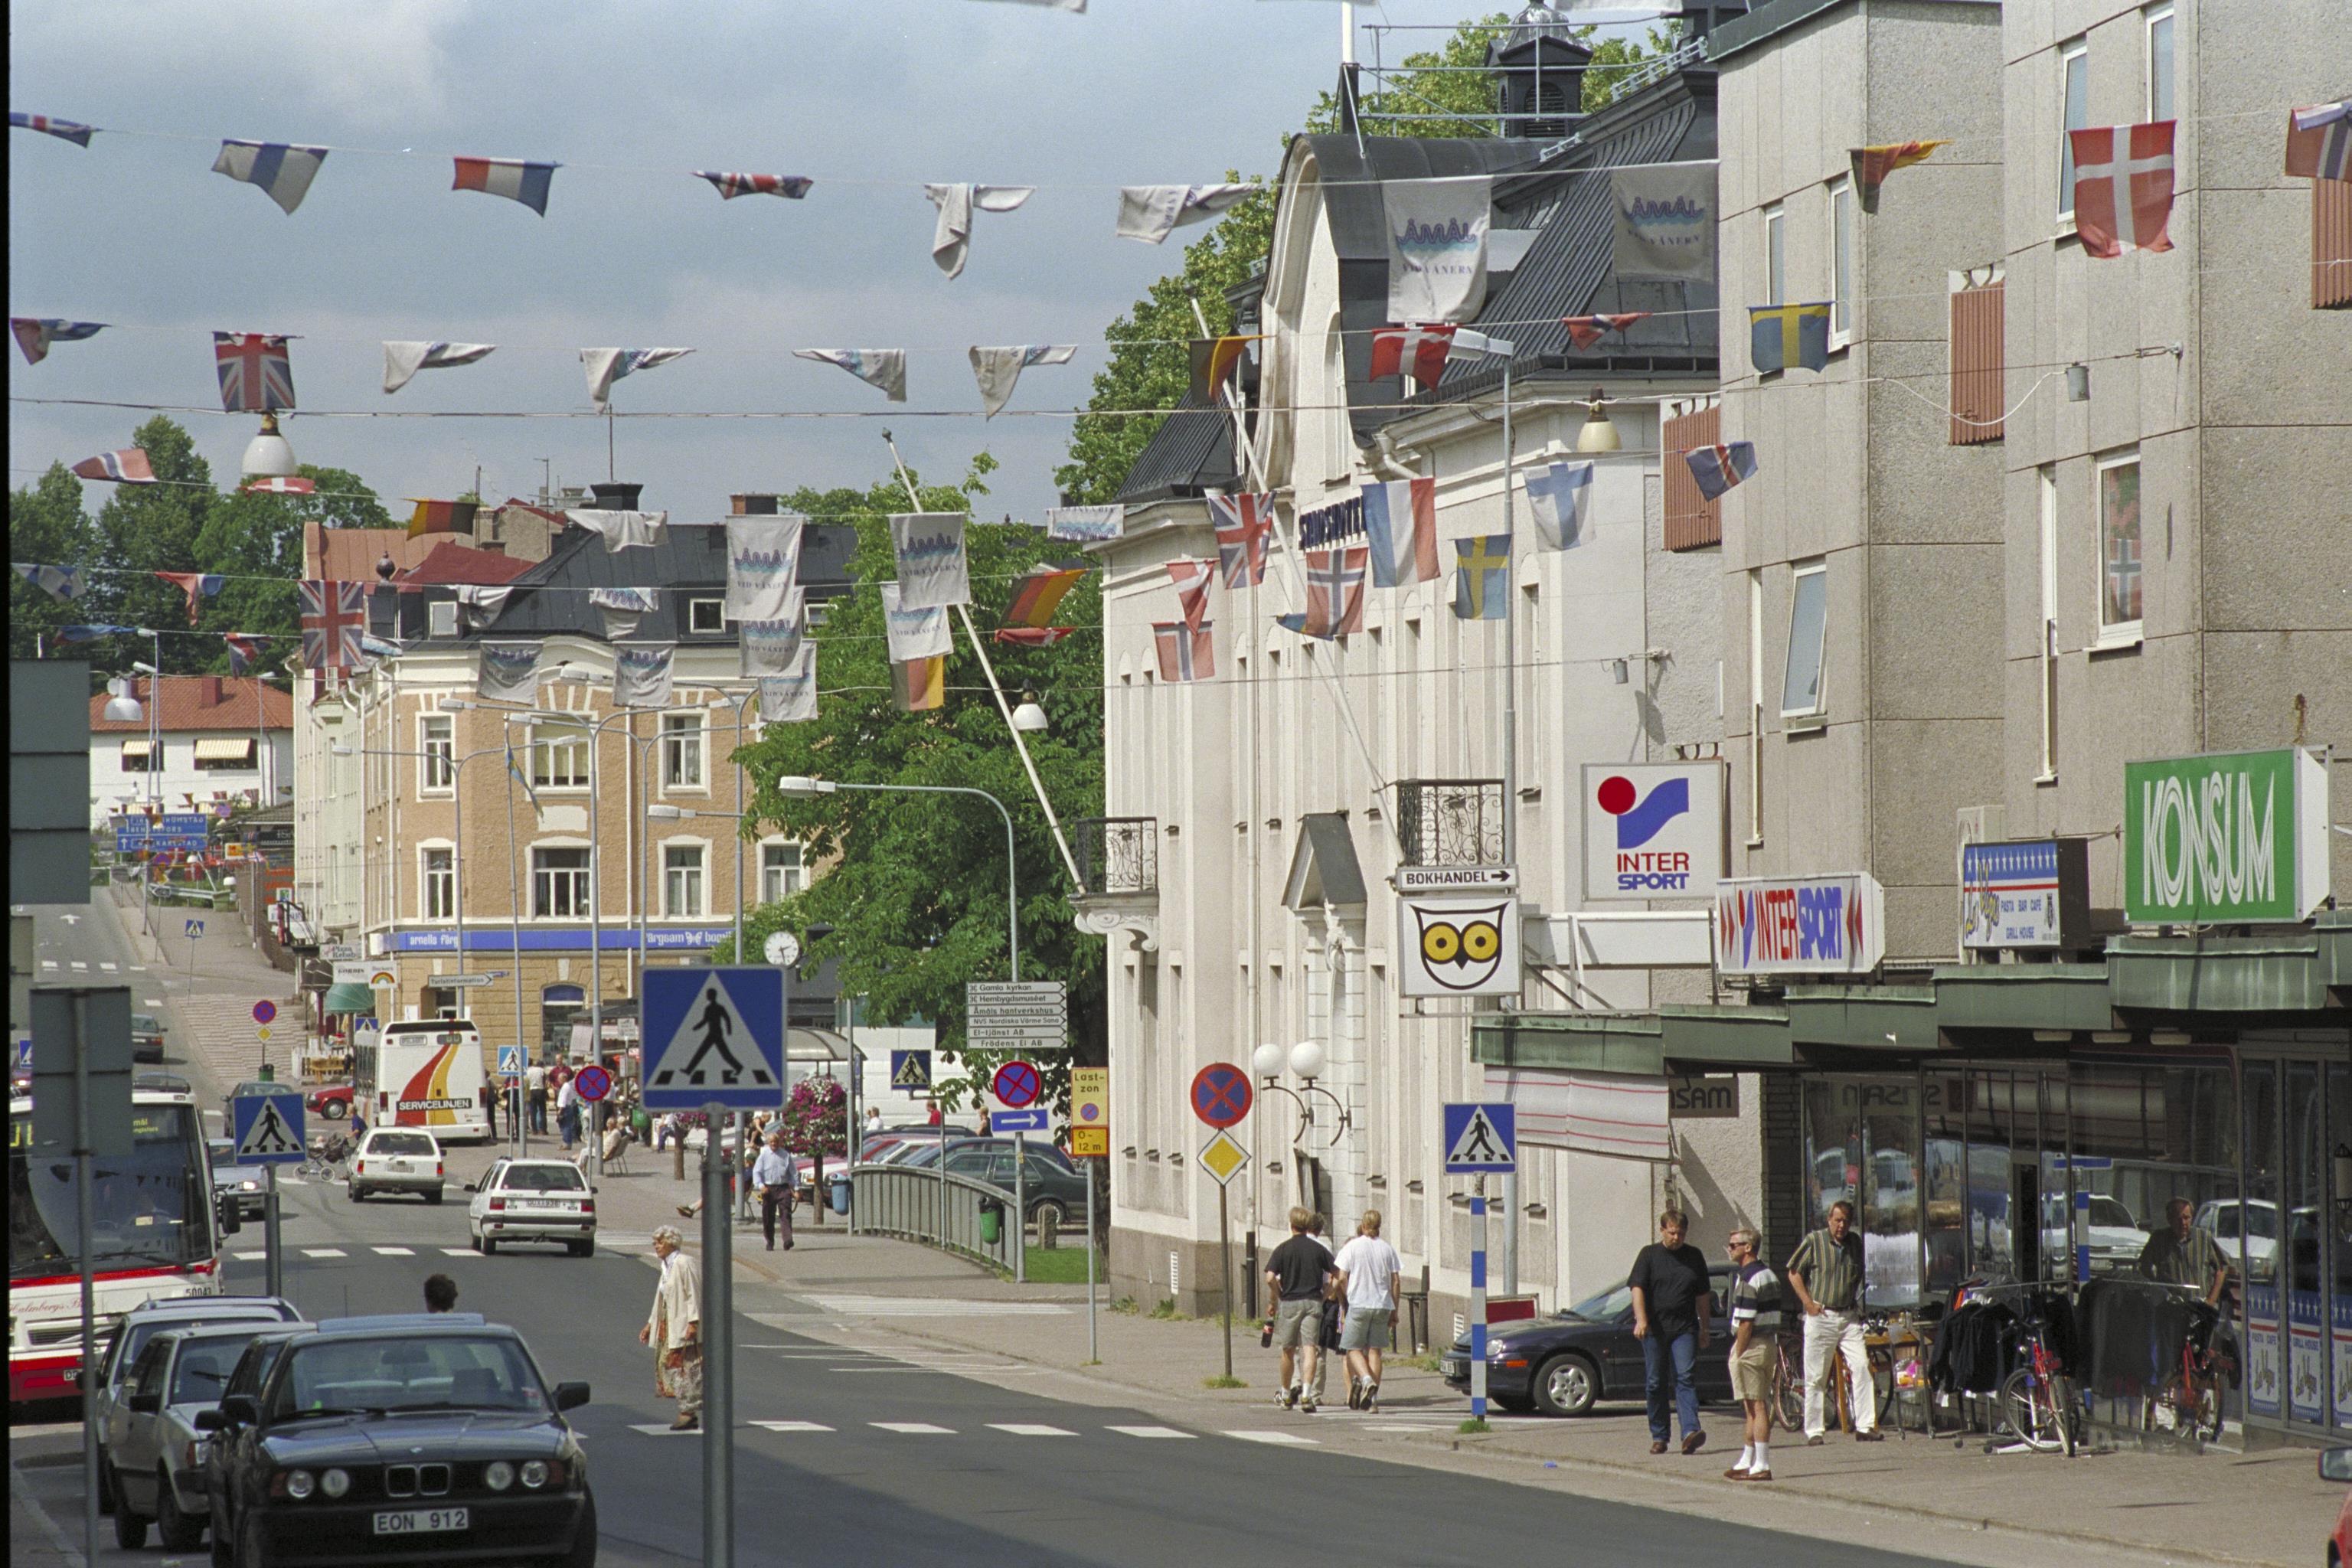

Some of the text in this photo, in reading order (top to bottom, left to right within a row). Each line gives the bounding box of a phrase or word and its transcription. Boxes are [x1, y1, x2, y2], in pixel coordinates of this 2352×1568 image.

[2144, 770, 2275, 909] KONSUM
[1617, 852, 1690, 872] INTER
[1406, 871, 1488, 885] BOKHANDEL
[1618, 873, 1690, 890] SPORT
[1756, 887, 1843, 962] INTER SPORT
[1006, 984, 1032, 992] kyrkan
[1074, 1072, 1105, 1082] Last-
[1080, 1085, 1099, 1093] zon
[399, 1099, 469, 1111] SERVICELINJEN
[1079, 1143, 1089, 1152] 12
[377, 1511, 465, 1531] EON 912
